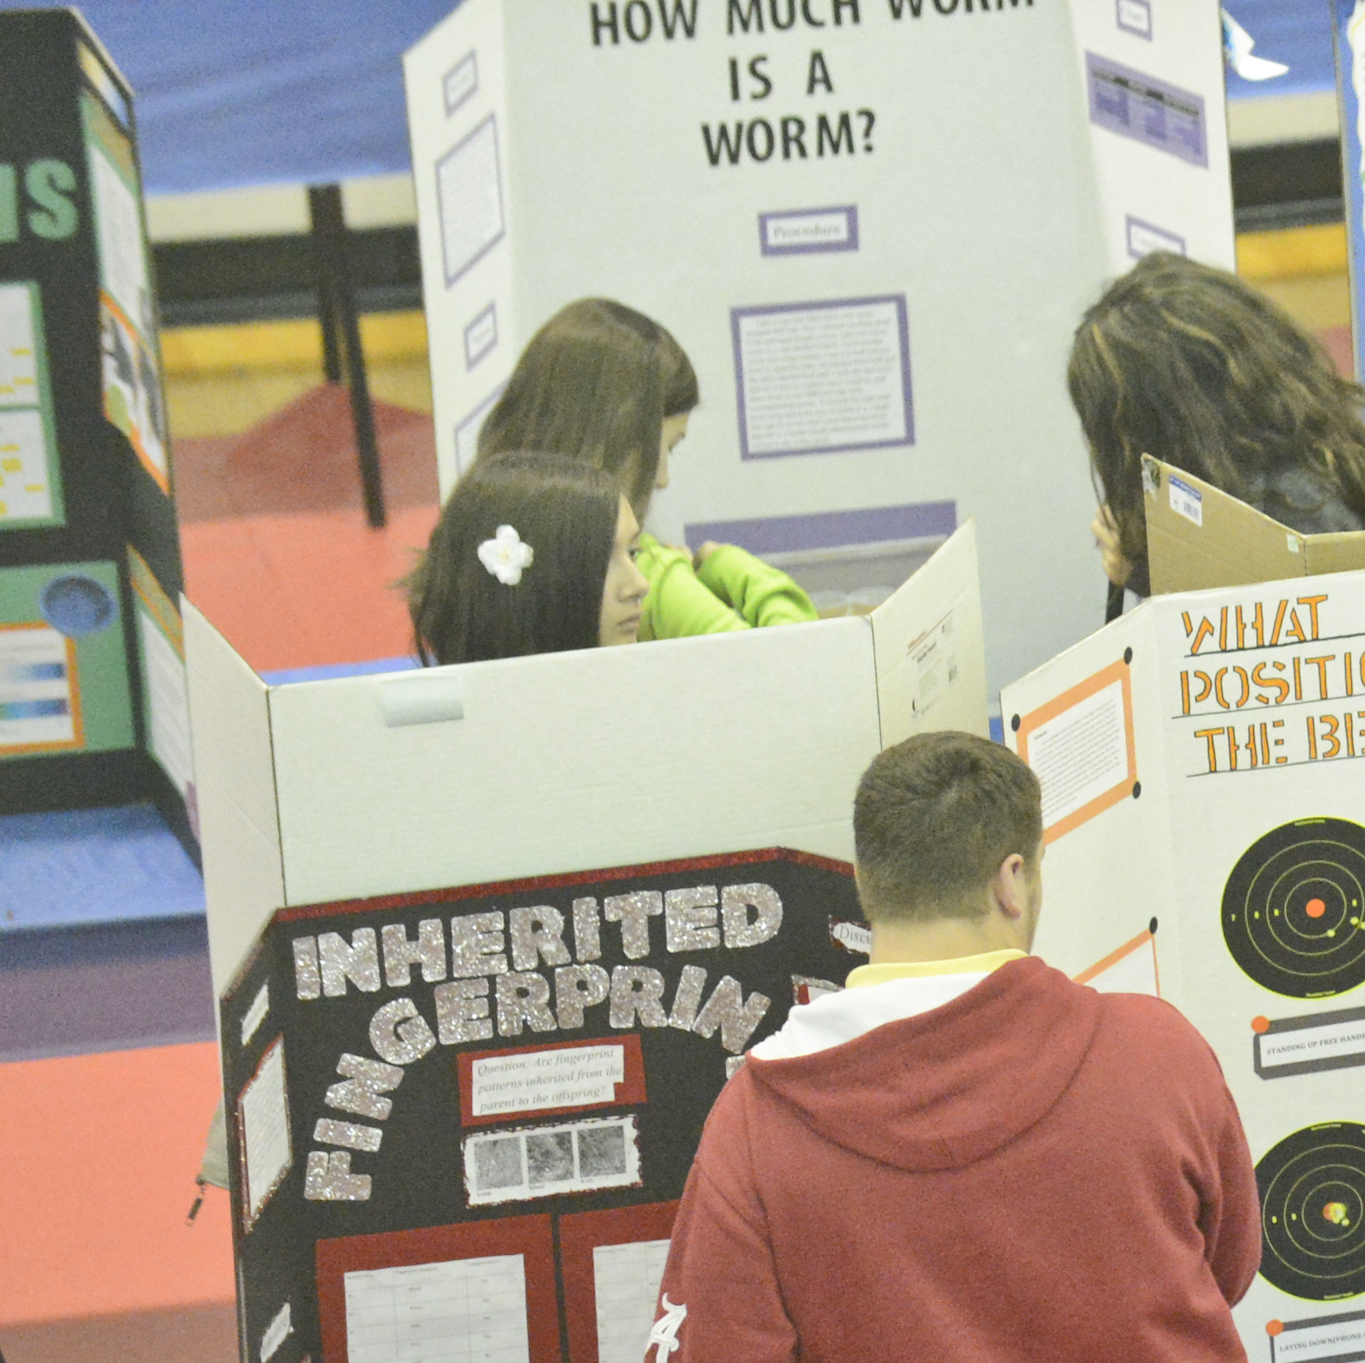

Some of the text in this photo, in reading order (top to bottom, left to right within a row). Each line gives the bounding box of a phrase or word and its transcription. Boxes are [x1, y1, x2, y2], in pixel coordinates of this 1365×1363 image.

[591, 0, 698, 46] HOW
[726, 0, 861, 36] MUCH
[729, 50, 836, 102] IS A
[700, 109, 878, 168] WORM?
[1180, 595, 1329, 655] WHAT
[1194, 727, 1288, 775] THE
[292, 882, 783, 999] INHERITED
[533, 1057, 553, 1068] Are
[554, 1049, 614, 1067] fingerprint
[1266, 1042, 1307, 1056] STANDING
[1307, 1040, 1319, 1049] UP
[1319, 1037, 1339, 1047] FREE
[478, 1066, 623, 1096] patterns inherited from the
[480, 1085, 607, 1114] parent to the offspring?
[1280, 1341, 1308, 1353] LAYING
